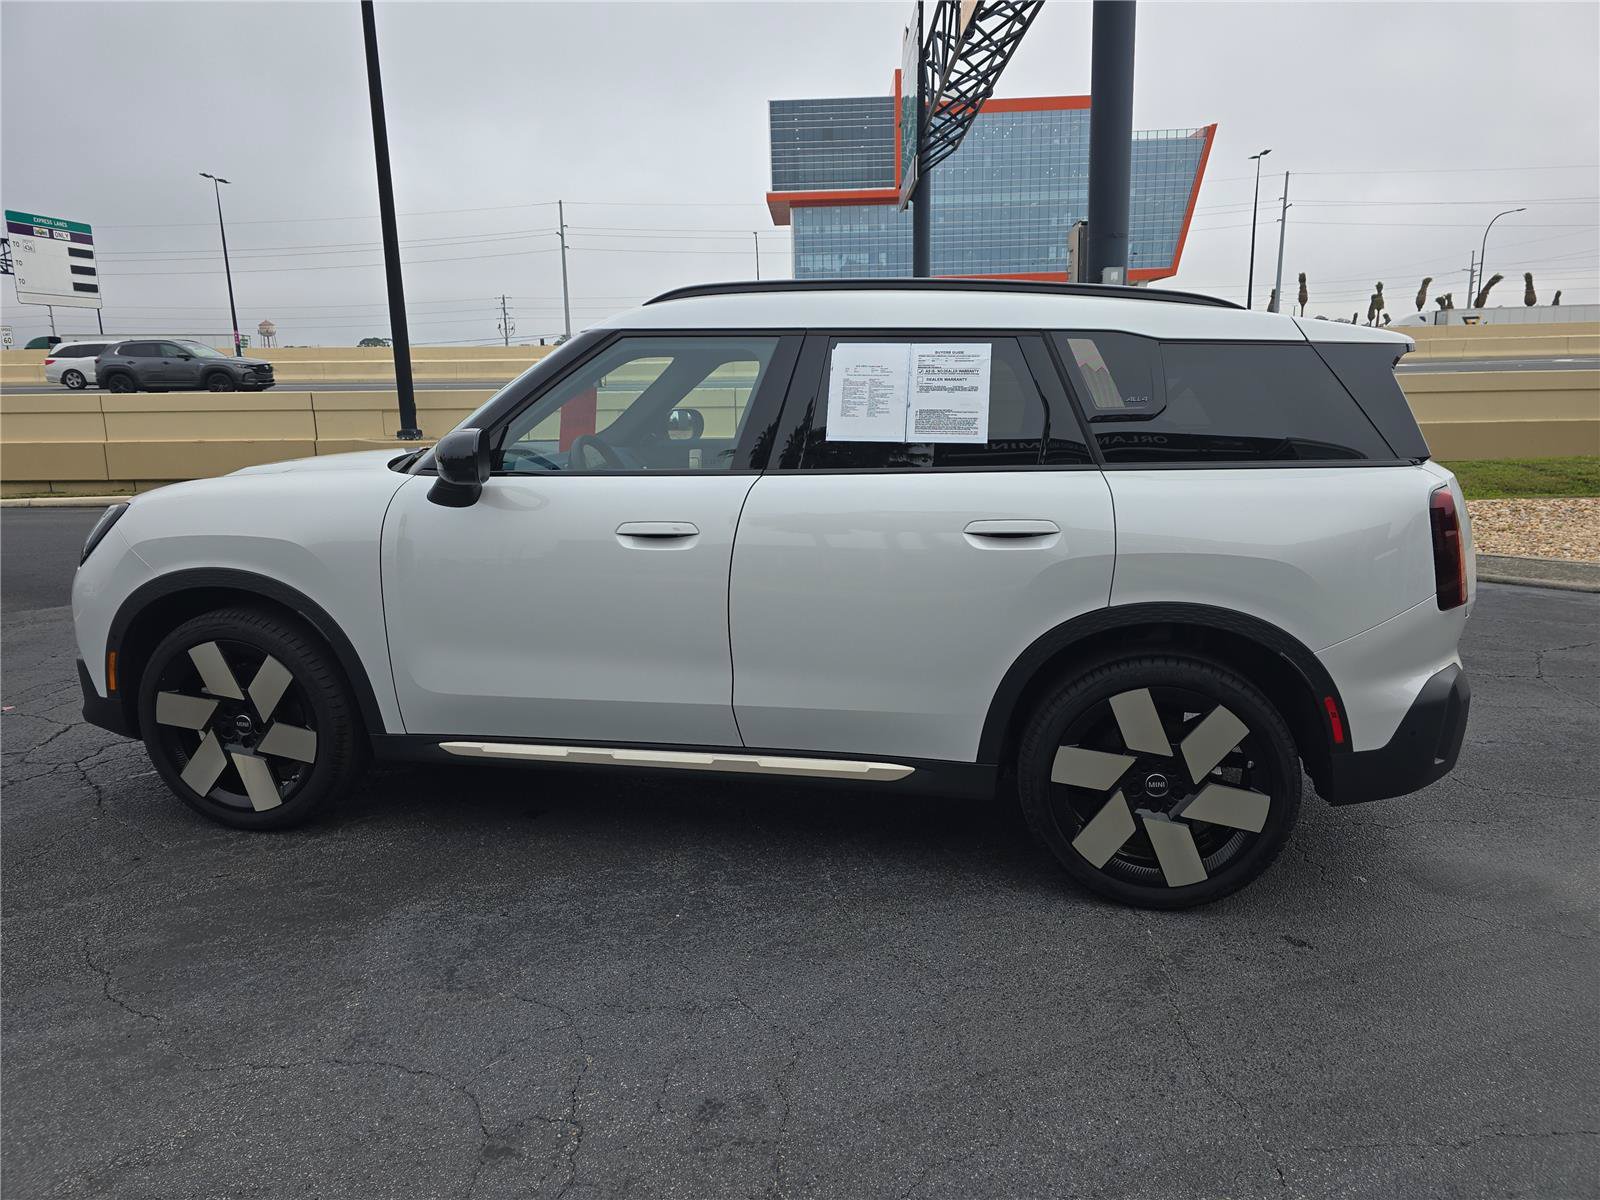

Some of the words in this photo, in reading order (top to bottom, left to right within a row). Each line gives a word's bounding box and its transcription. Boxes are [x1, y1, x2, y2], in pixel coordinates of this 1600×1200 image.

[33, 217, 52, 225] EXPRESS
[53, 220, 68, 228] LANES
[54, 231, 69, 239] ONLY
